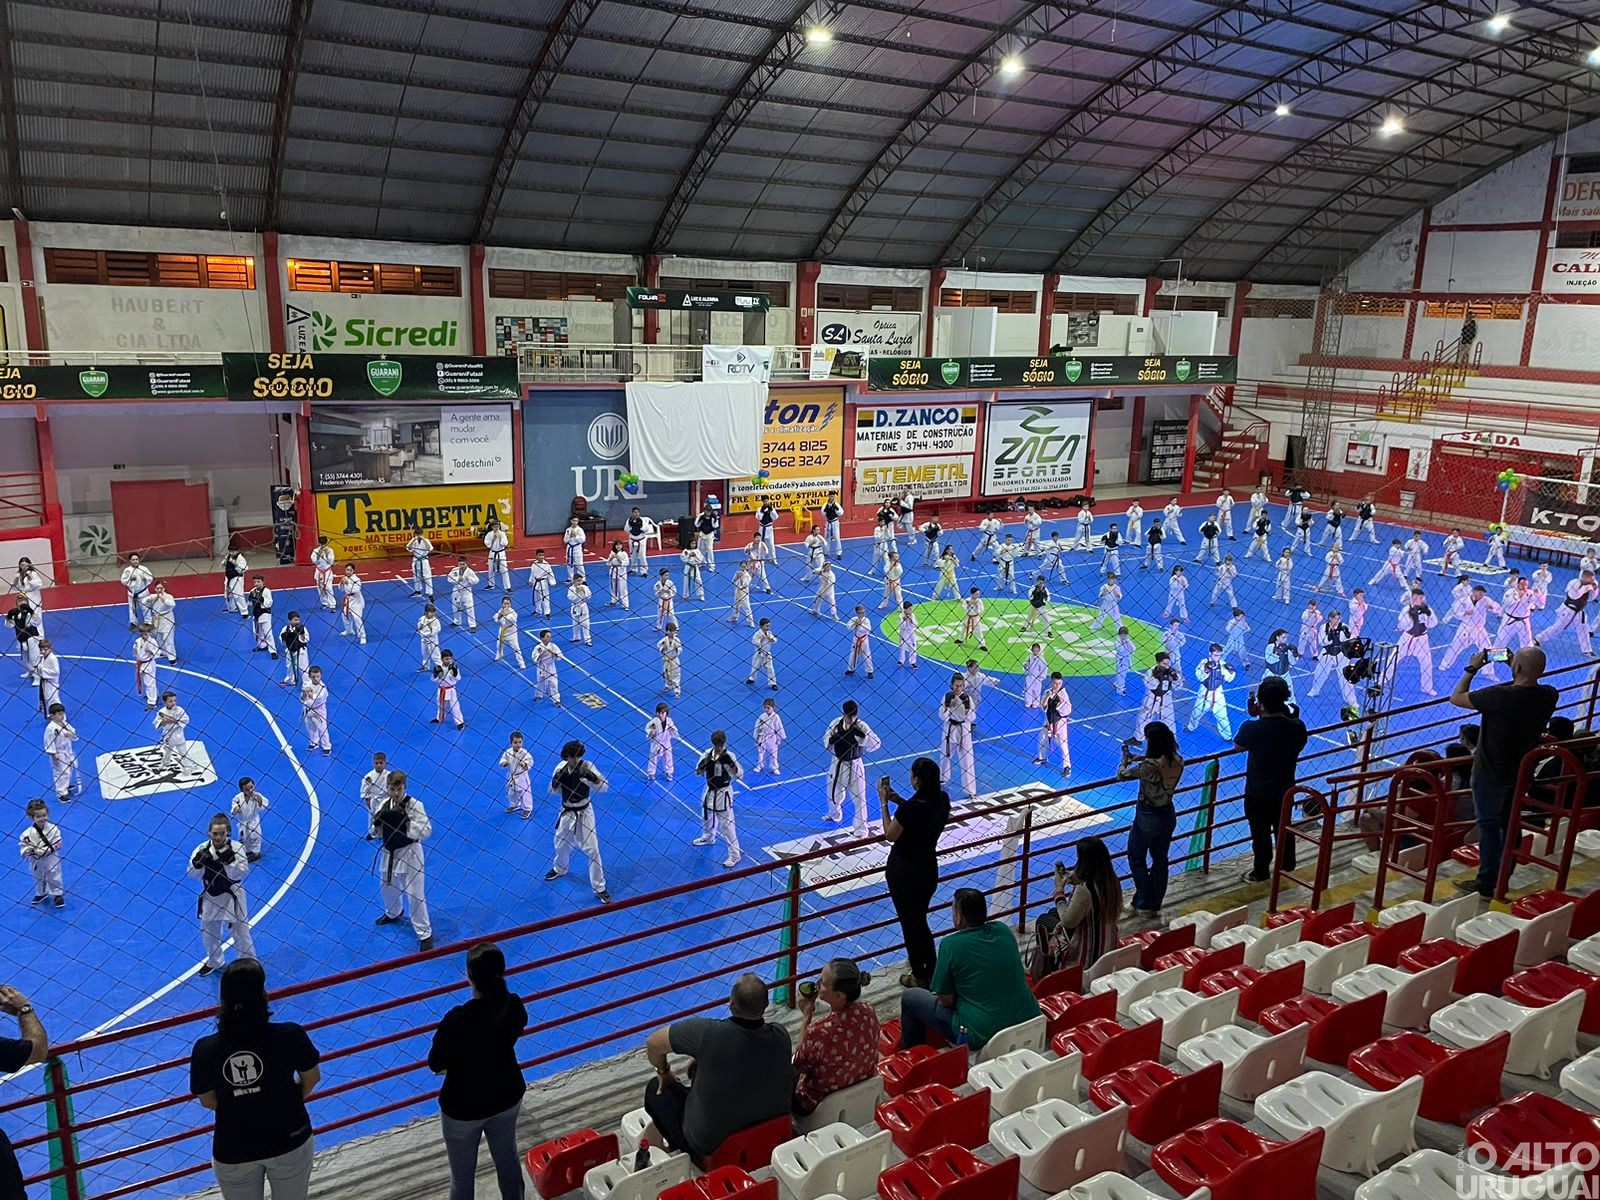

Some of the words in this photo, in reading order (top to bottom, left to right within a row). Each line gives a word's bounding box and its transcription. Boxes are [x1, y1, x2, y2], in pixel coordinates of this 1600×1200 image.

[1552, 263, 1600, 273] CAL
[1566, 279, 1597, 287] INJEÇÃO
[112, 297, 204, 314] HAUBERT
[152, 317, 166, 331] &
[344, 319, 458, 347] Sicredi
[852, 329, 883, 344] Santa
[884, 330, 913, 348] Luzia
[116, 333, 147, 348] CIA
[267, 353, 314, 369] SEJA
[900, 360, 921, 370] SEJA
[1029, 359, 1049, 368] SEJA
[1144, 358, 1161, 367] SEJA
[370, 367, 400, 377] GUARANI
[252, 370, 333, 398] SÓCIO
[450, 413, 458, 421] A
[459, 414, 482, 424] gente
[895, 407, 960, 427] ZANCO
[450, 424, 476, 433] mudar
[857, 430, 902, 441] MATERIAIS
[906, 430, 918, 439] DE
[922, 427, 974, 438] CONSTRUÇÃO
[763, 441, 796, 454] 3744
[799, 440, 828, 452] 8125
[995, 434, 1081, 465] ZACA
[452, 459, 494, 469] Todeschini
[761, 456, 796, 469] 9962
[798, 455, 831, 467] 3247
[863, 463, 969, 485] STEMETAL
[993, 464, 1072, 479] SPORTS
[1530, 507, 1600, 532] KTO
[428, 530, 443, 540] DE
[112, 752, 151, 778] SUPER
